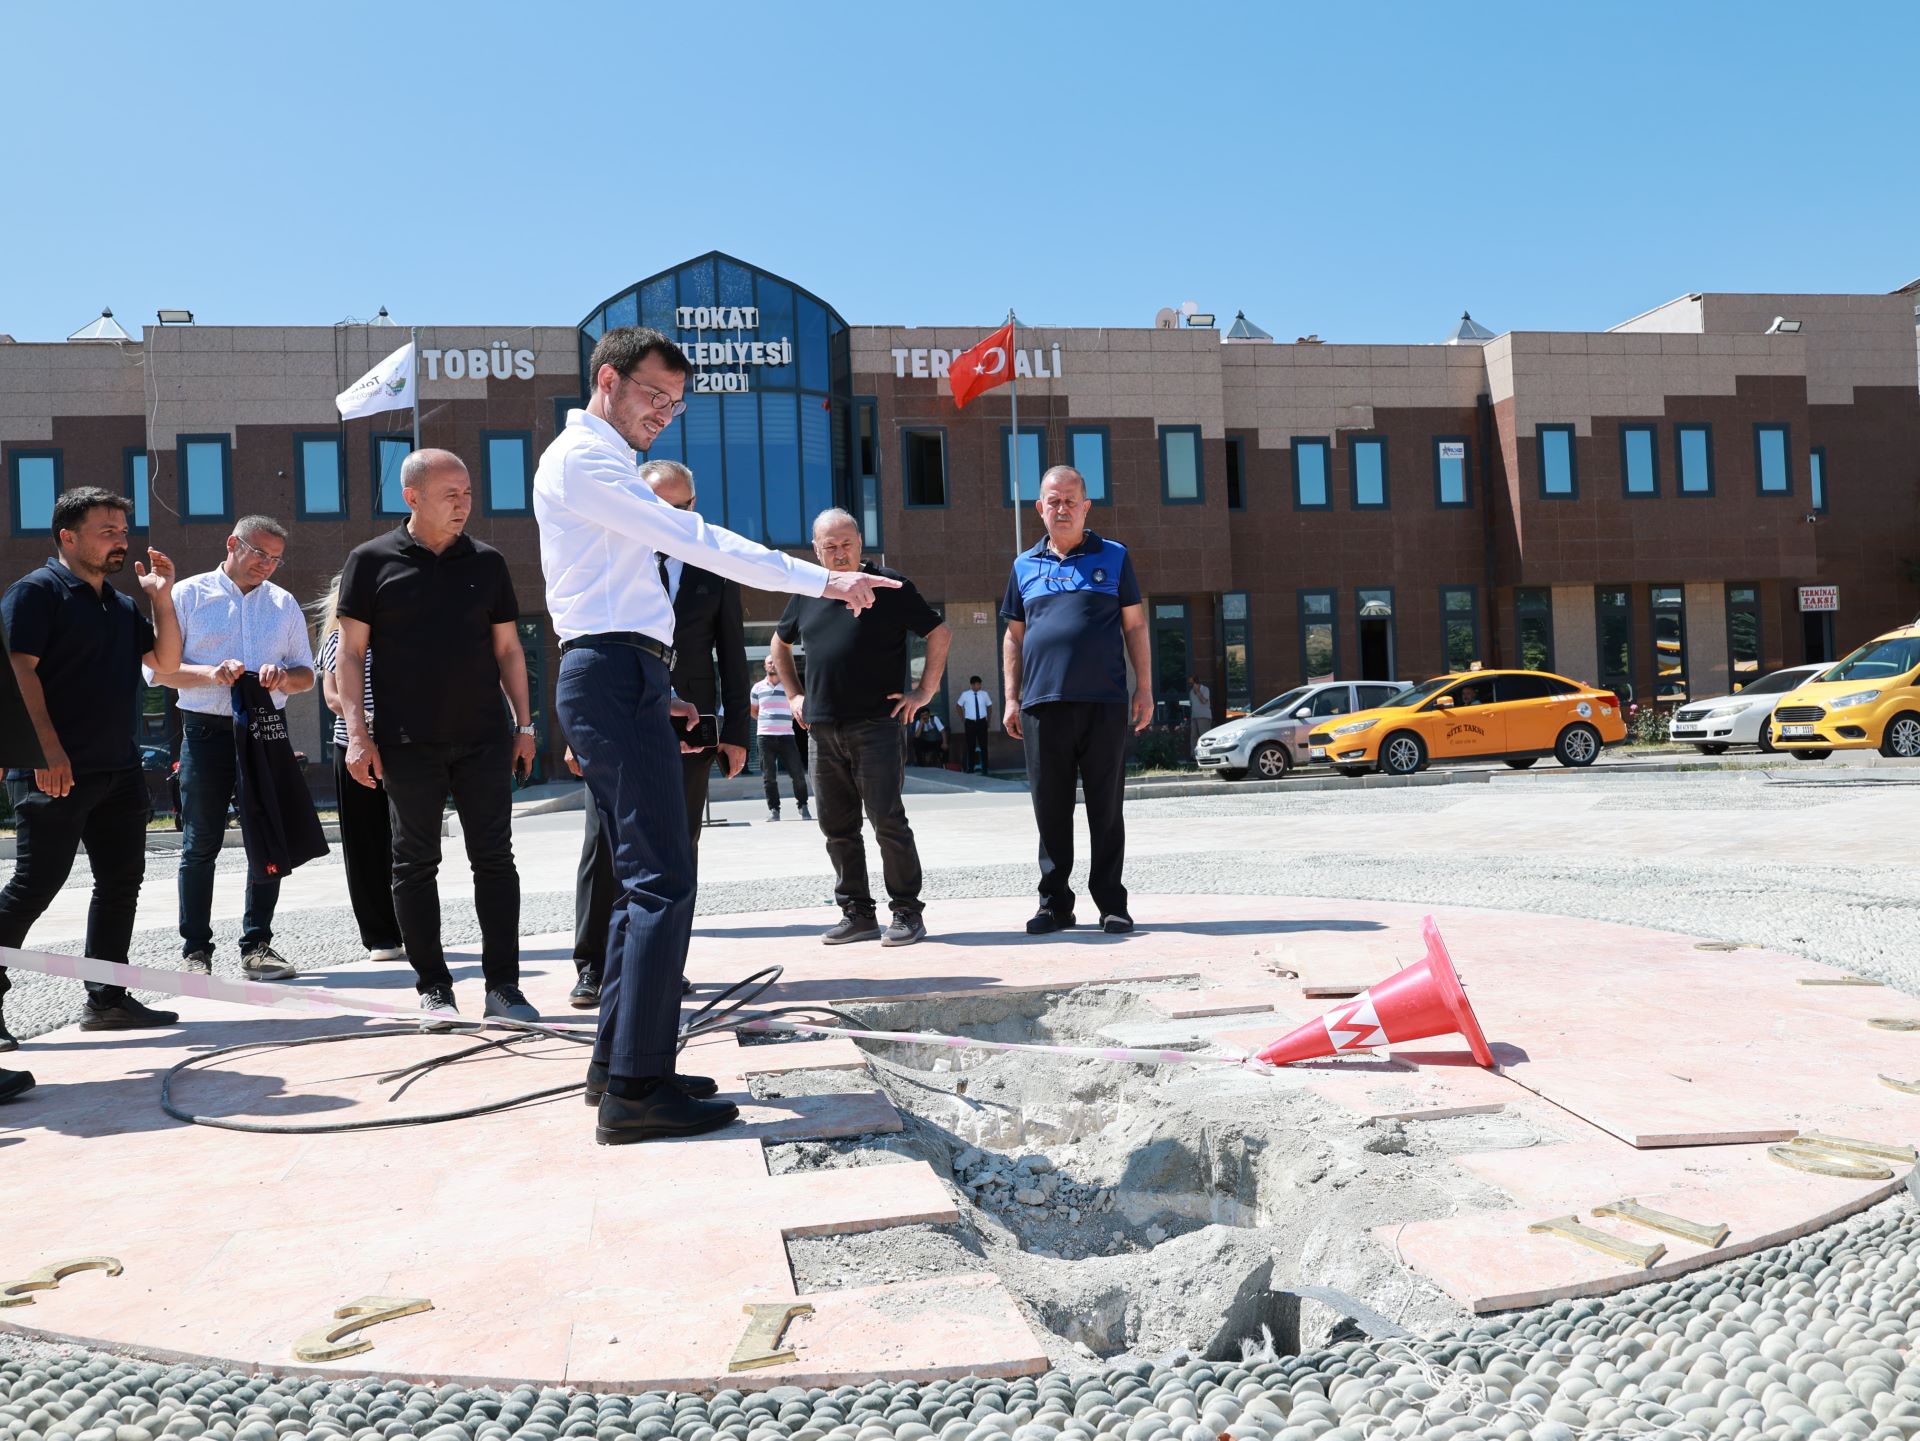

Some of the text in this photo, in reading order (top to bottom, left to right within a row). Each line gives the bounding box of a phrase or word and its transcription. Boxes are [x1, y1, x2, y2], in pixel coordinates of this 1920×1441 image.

[679, 306, 756, 330] TOKAT
[418, 340, 536, 381] TOBÜS
[674, 336, 789, 366] LEDİYESİ
[695, 372, 746, 393] 2001
[1801, 588, 1837, 597] TERMİNAL
[1804, 596, 1834, 605] TAKSİ
